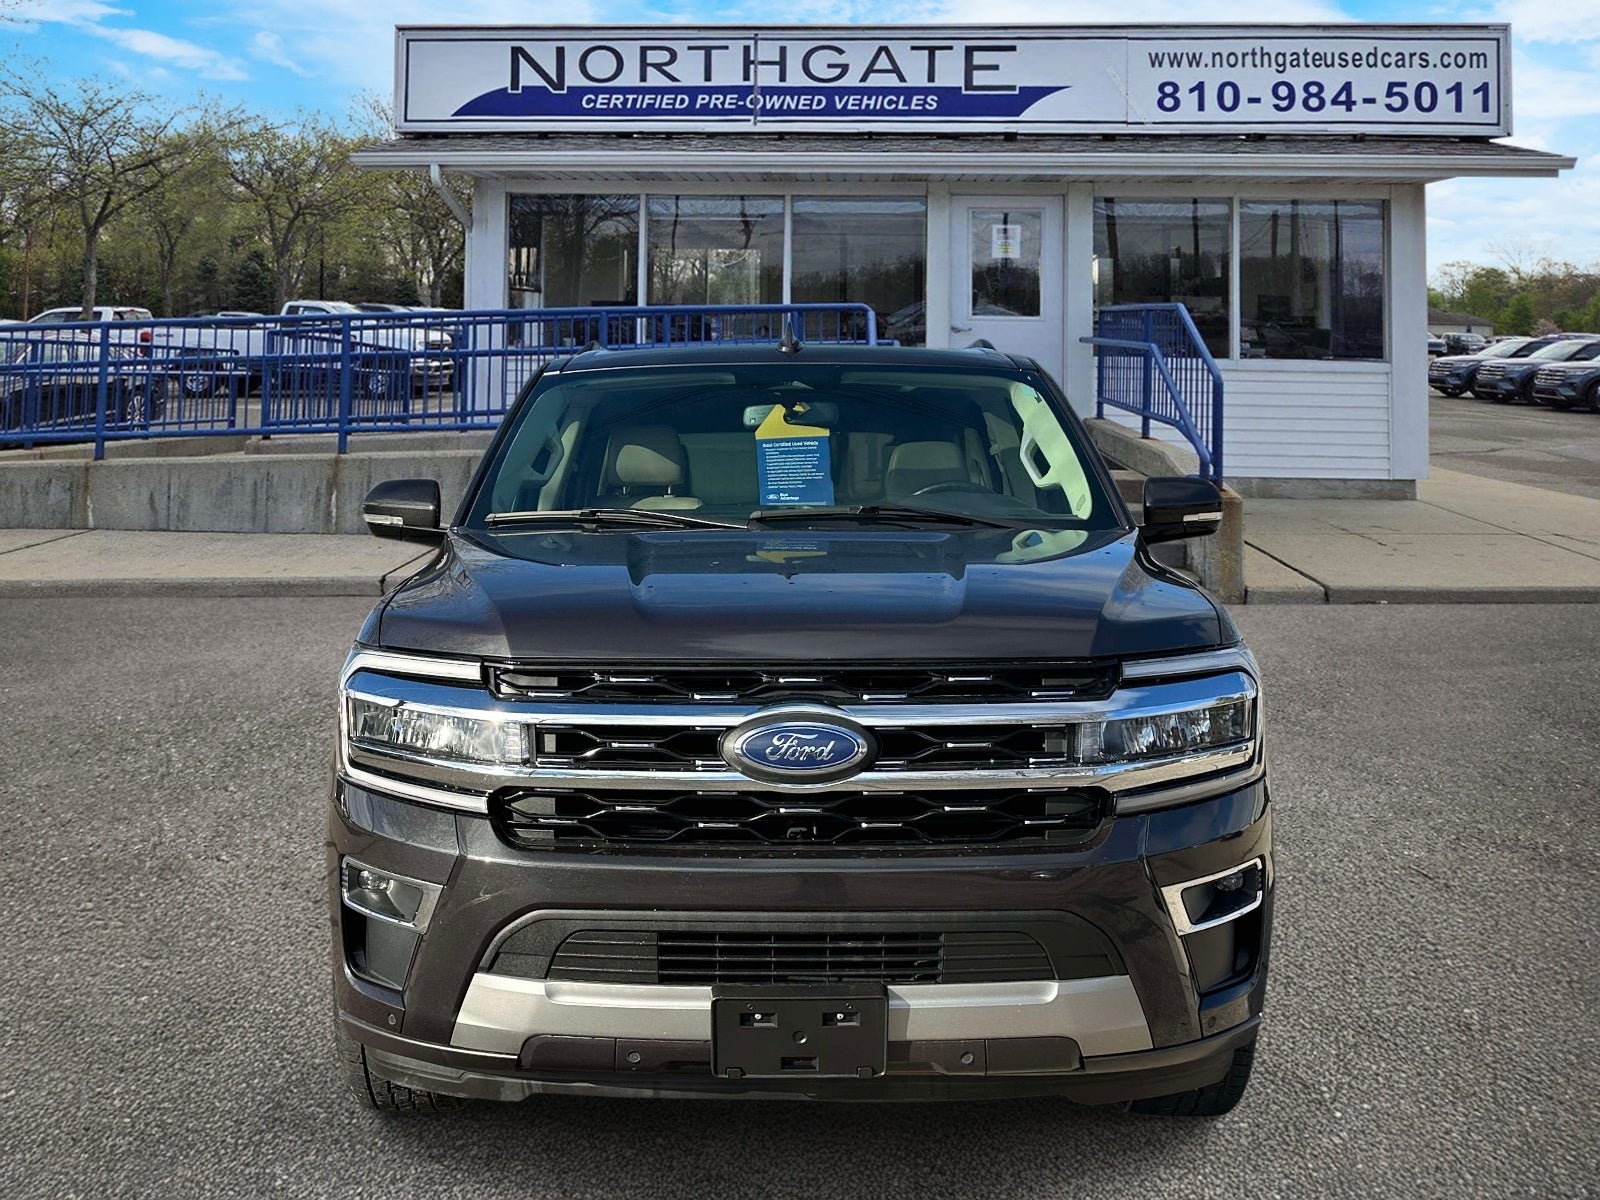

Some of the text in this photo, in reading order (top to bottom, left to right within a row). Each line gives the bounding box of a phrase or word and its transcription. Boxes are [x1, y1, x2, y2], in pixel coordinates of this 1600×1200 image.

[510, 45, 1016, 92] NORTHGATE
[1148, 46, 1488, 73] www.northgateusedcars.com
[581, 94, 939, 111] CERTIFIED PRE-OWNED VEHICLES
[1156, 80, 1491, 113] 810-984-5011
[765, 732, 836, 760] Ford
